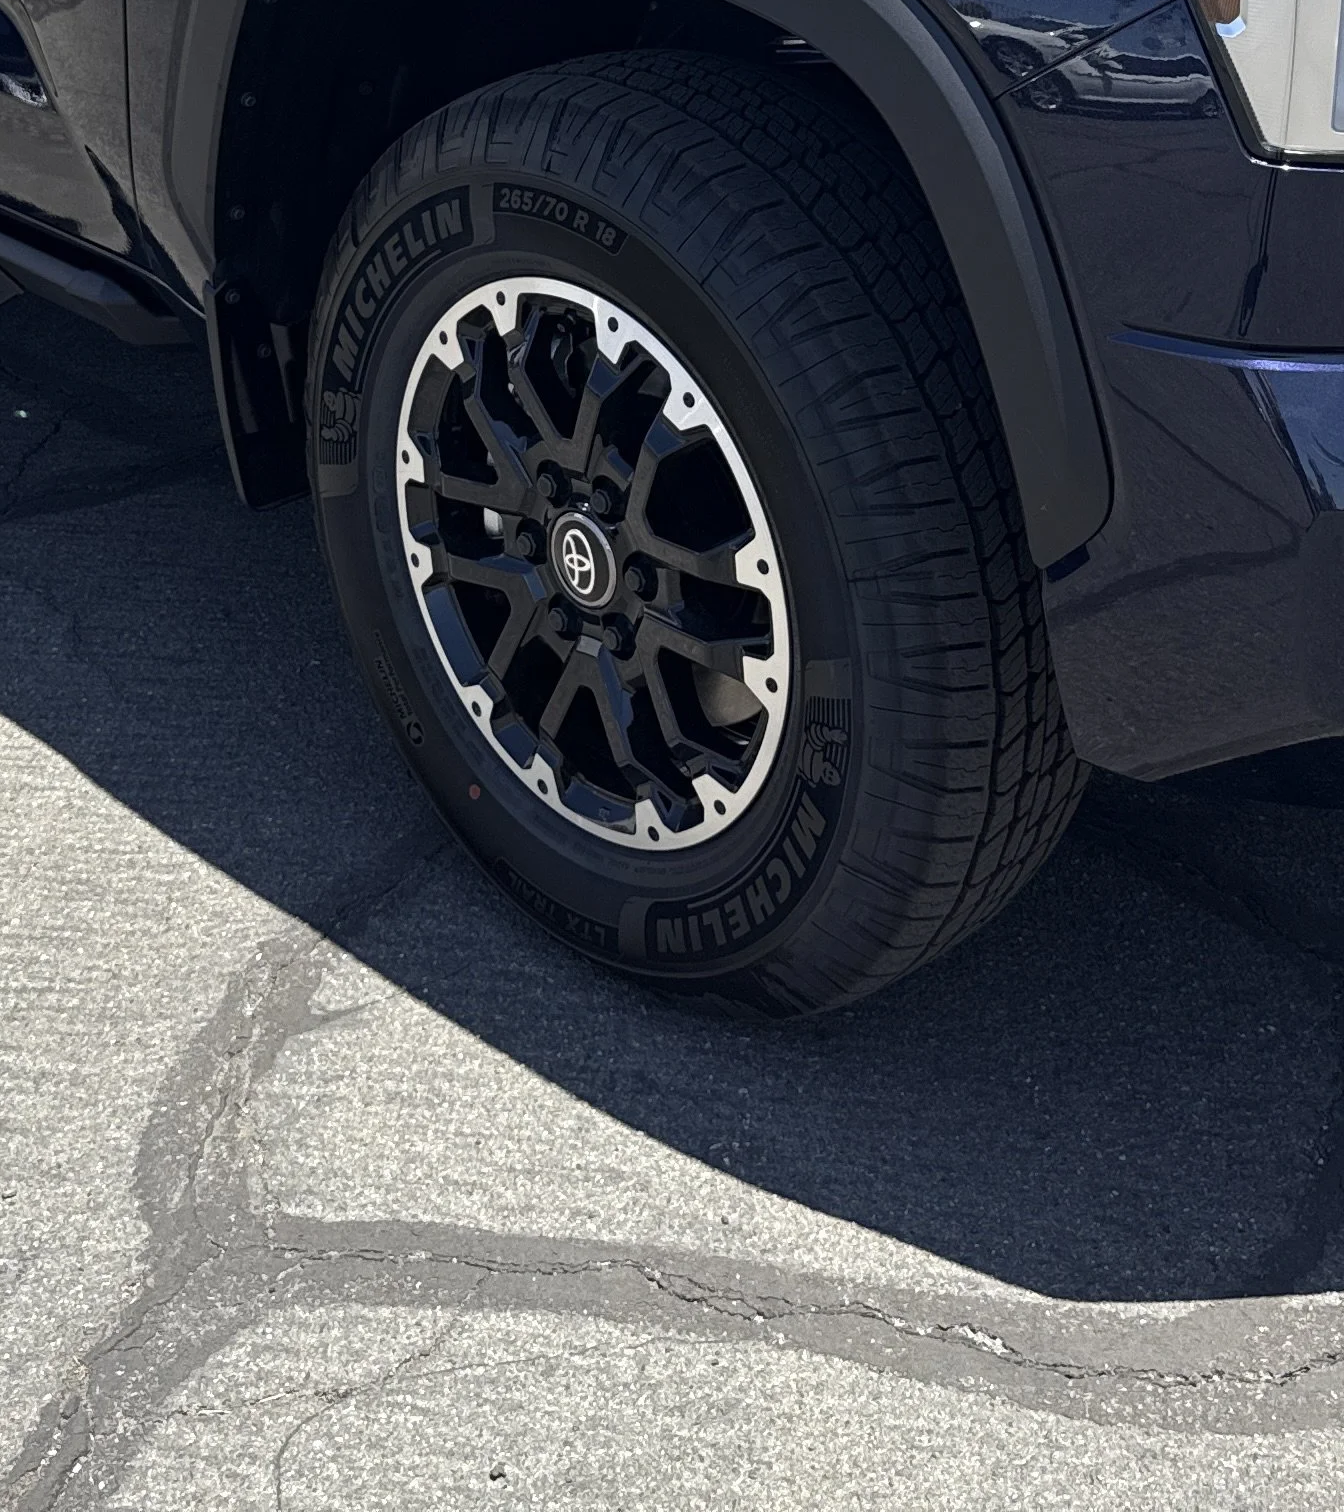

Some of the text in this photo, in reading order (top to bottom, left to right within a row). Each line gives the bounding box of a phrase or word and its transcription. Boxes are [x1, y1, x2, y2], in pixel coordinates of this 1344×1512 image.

[331, 198, 465, 385] MICHELIN
[499, 186, 618, 248] 265/70 R 18
[655, 790, 828, 954] MICHELIN
